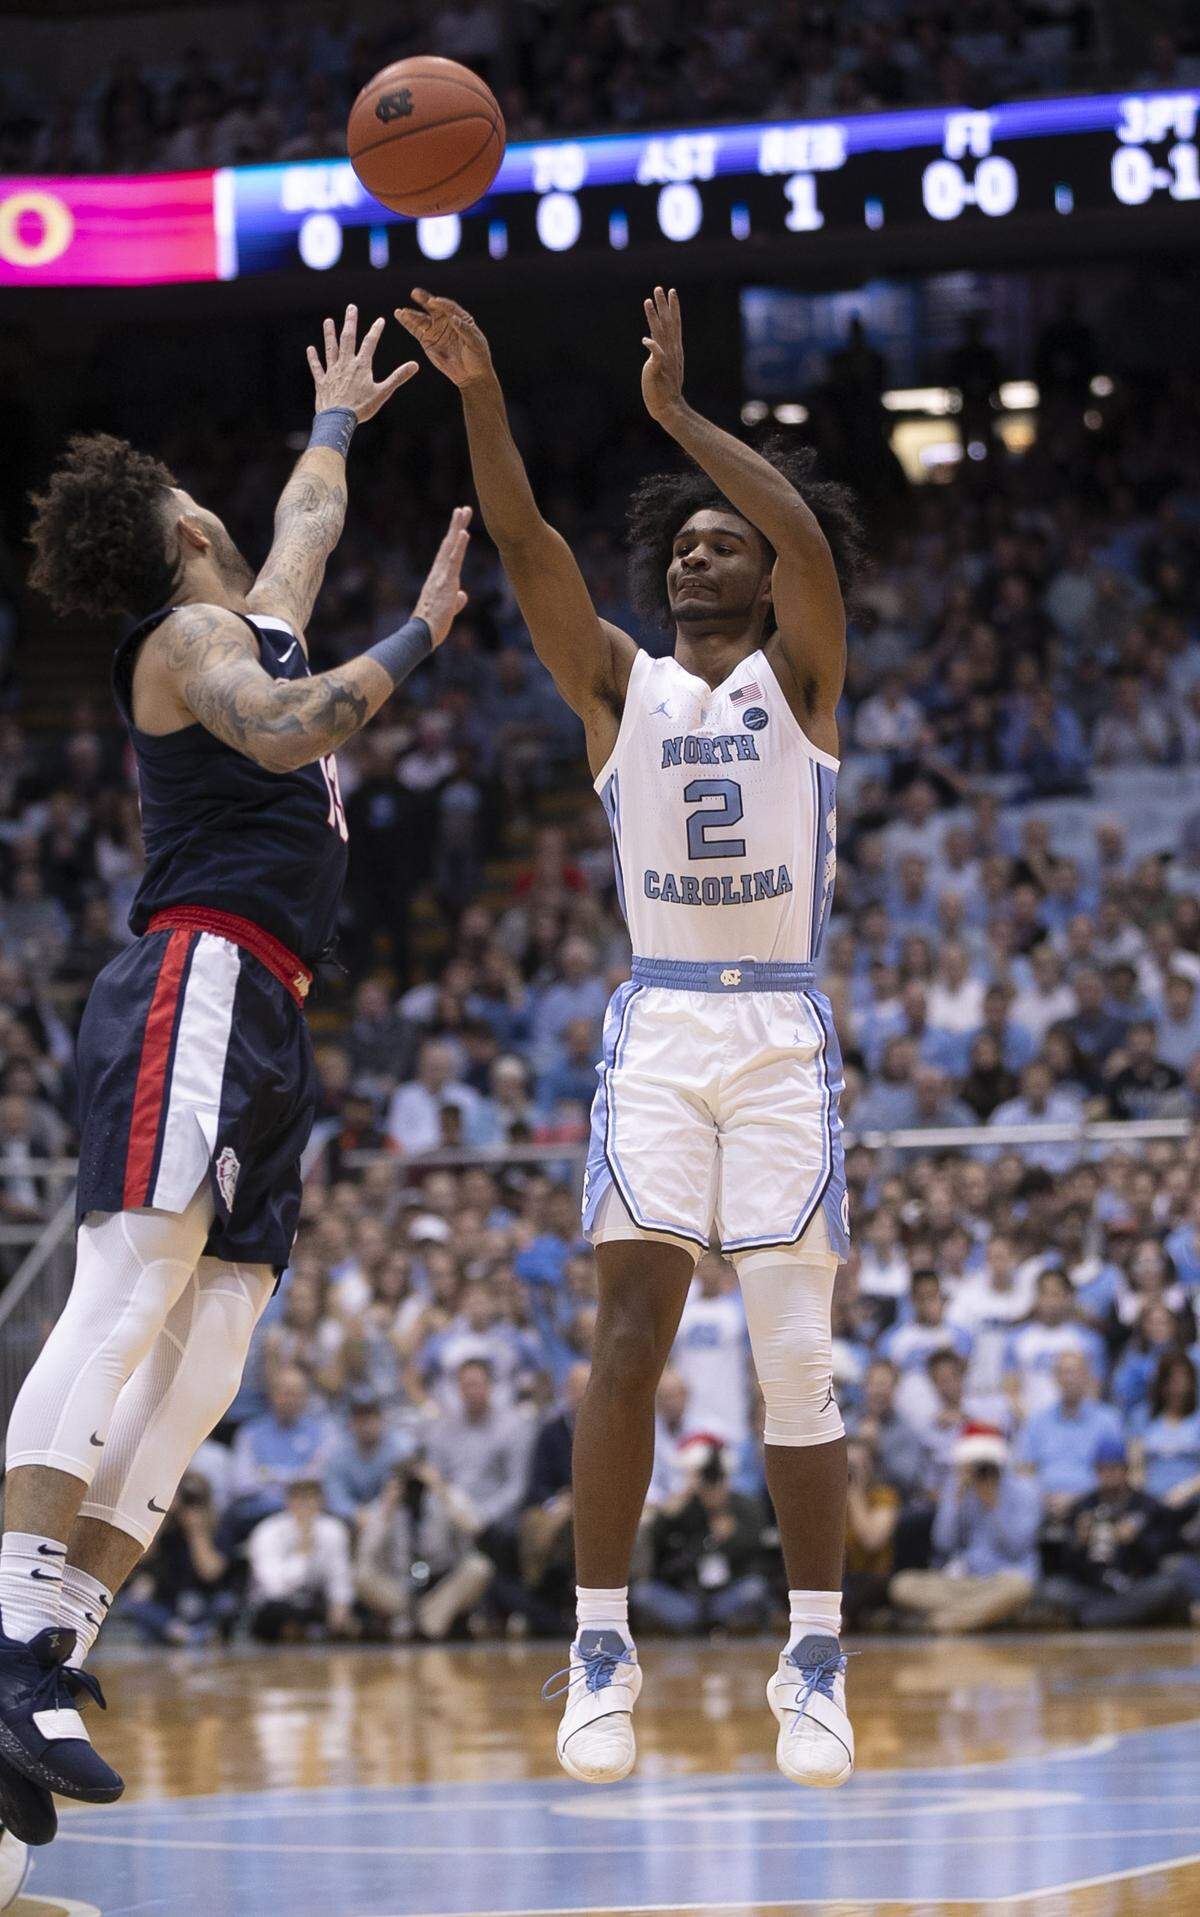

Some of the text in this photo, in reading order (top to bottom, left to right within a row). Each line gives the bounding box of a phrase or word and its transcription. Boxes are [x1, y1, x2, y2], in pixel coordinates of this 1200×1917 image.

[636, 134, 717, 186] AST
[943, 109, 997, 160] FT
[1115, 95, 1198, 144] 3PT
[299, 212, 343, 271] 0
[536, 191, 582, 251] 0
[657, 182, 703, 242] 0
[783, 173, 825, 232] 1
[922, 155, 1018, 221] 0-0
[1110, 141, 1200, 205] 0-1
[661, 734, 760, 768] NORTH
[683, 778, 747, 861] 2
[643, 864, 793, 906] CAROLINA
